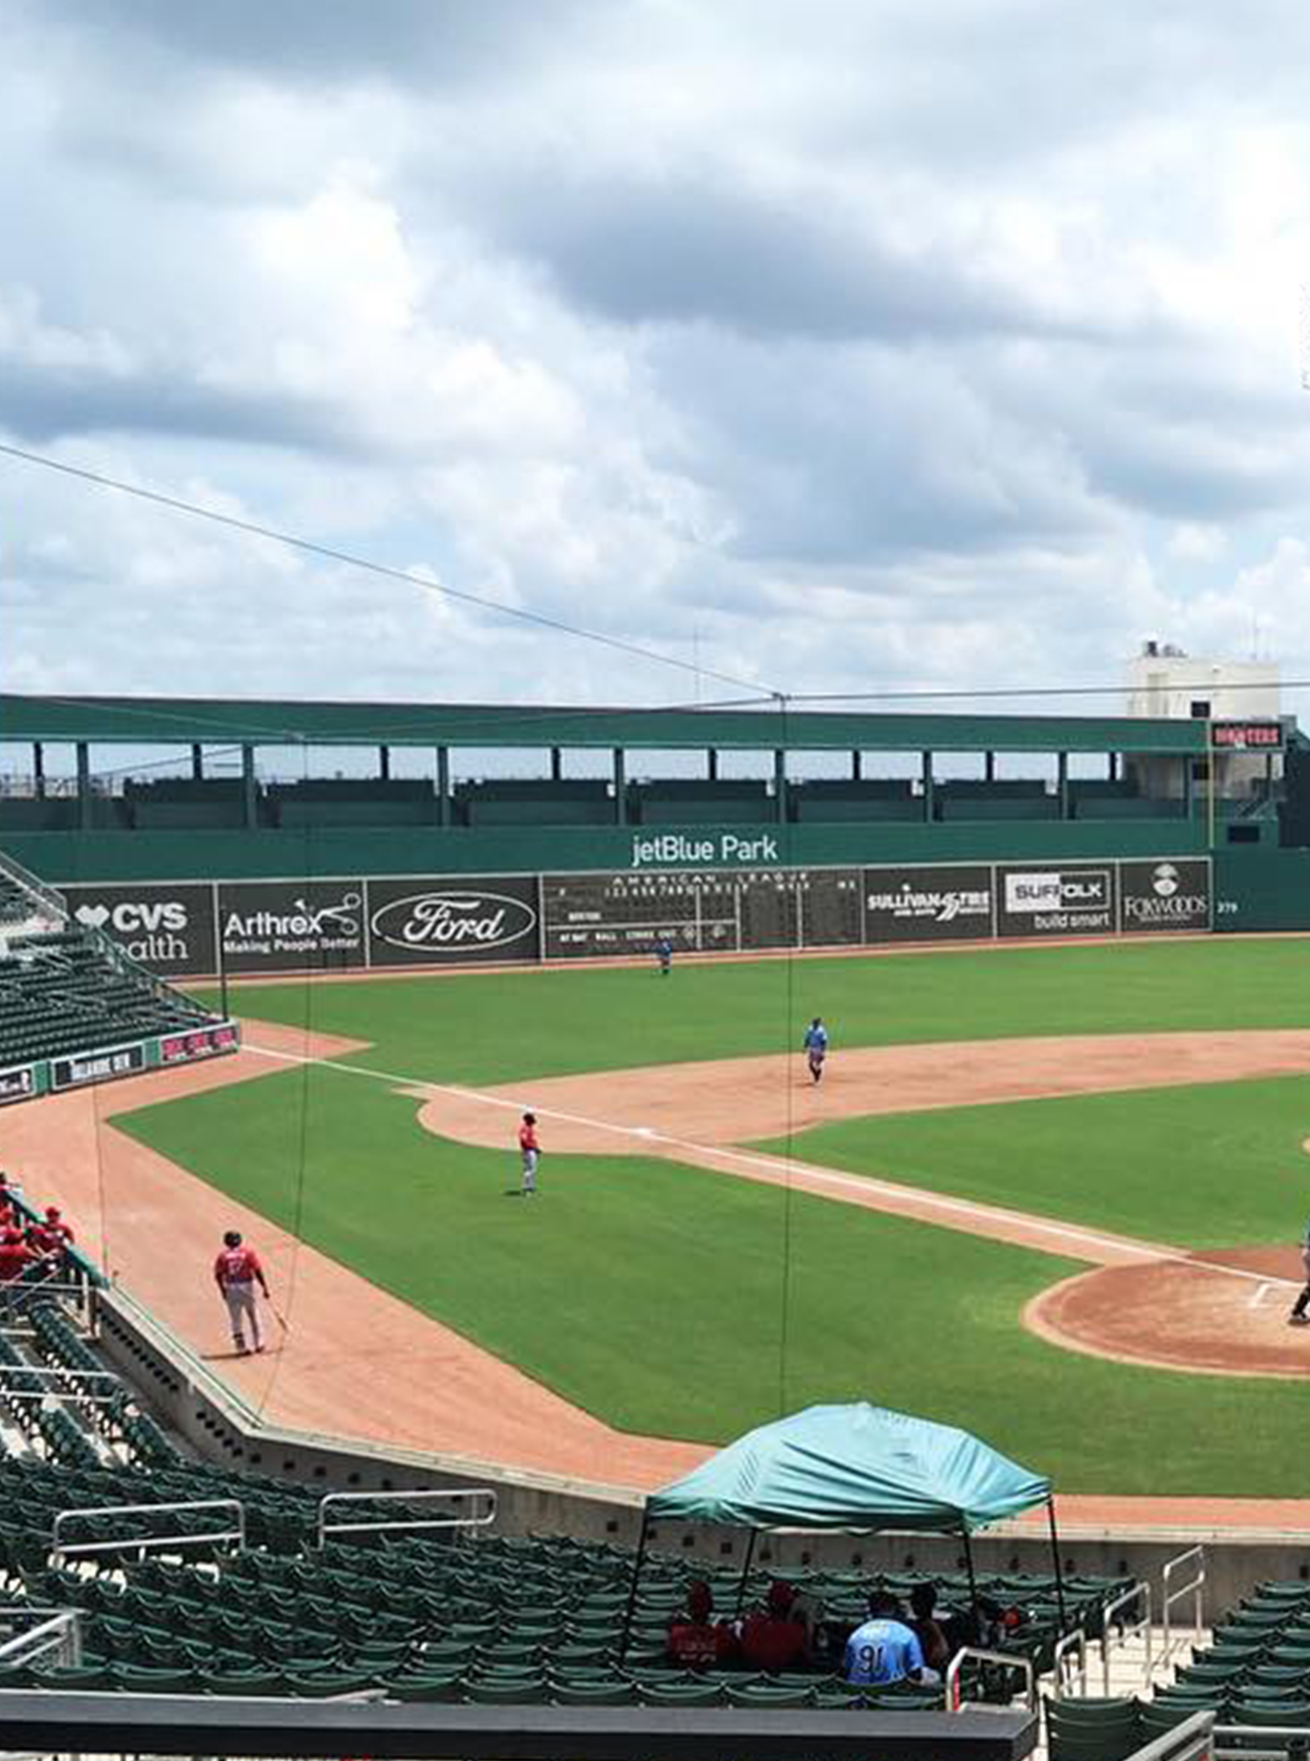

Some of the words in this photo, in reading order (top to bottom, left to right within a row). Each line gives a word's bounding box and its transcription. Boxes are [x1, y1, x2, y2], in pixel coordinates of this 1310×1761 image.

[632, 835, 715, 868] jetBlue
[721, 834, 779, 861] Park
[1015, 883, 1103, 900] SUFFOLK
[111, 902, 189, 932] CVS
[223, 905, 324, 938] Arthrex
[402, 900, 506, 942] Ford
[1034, 913, 1068, 929] build
[1069, 912, 1109, 927] smart
[857, 1643, 885, 1674] 91
